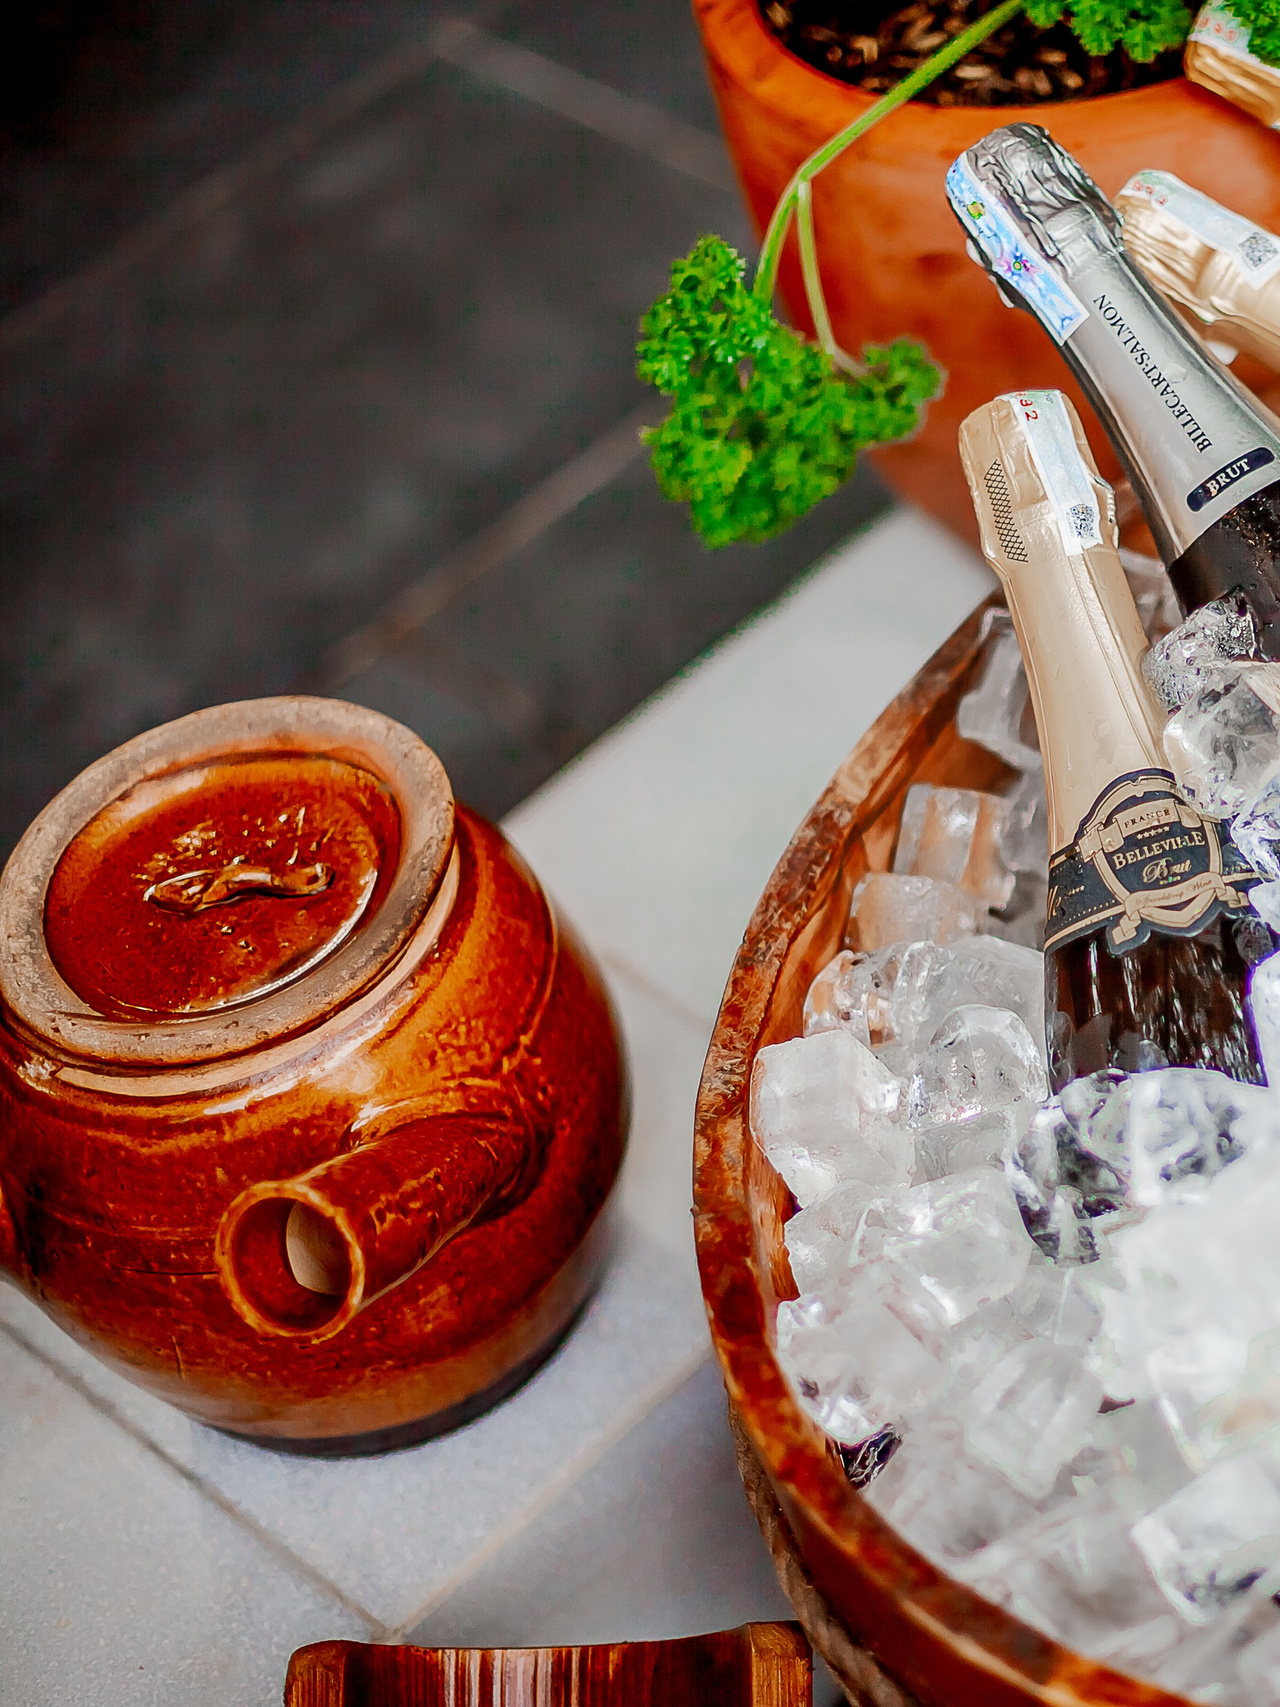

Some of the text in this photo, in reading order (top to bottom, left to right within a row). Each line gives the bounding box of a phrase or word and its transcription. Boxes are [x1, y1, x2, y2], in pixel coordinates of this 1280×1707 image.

[1093, 294, 1213, 454] BILLECART-SALMON
[1206, 457, 1252, 497] BRUT
[1123, 808, 1171, 829] FRANCE
[1112, 831, 1206, 870] BELLEVILLE
[1142, 857, 1192, 883] Brut
